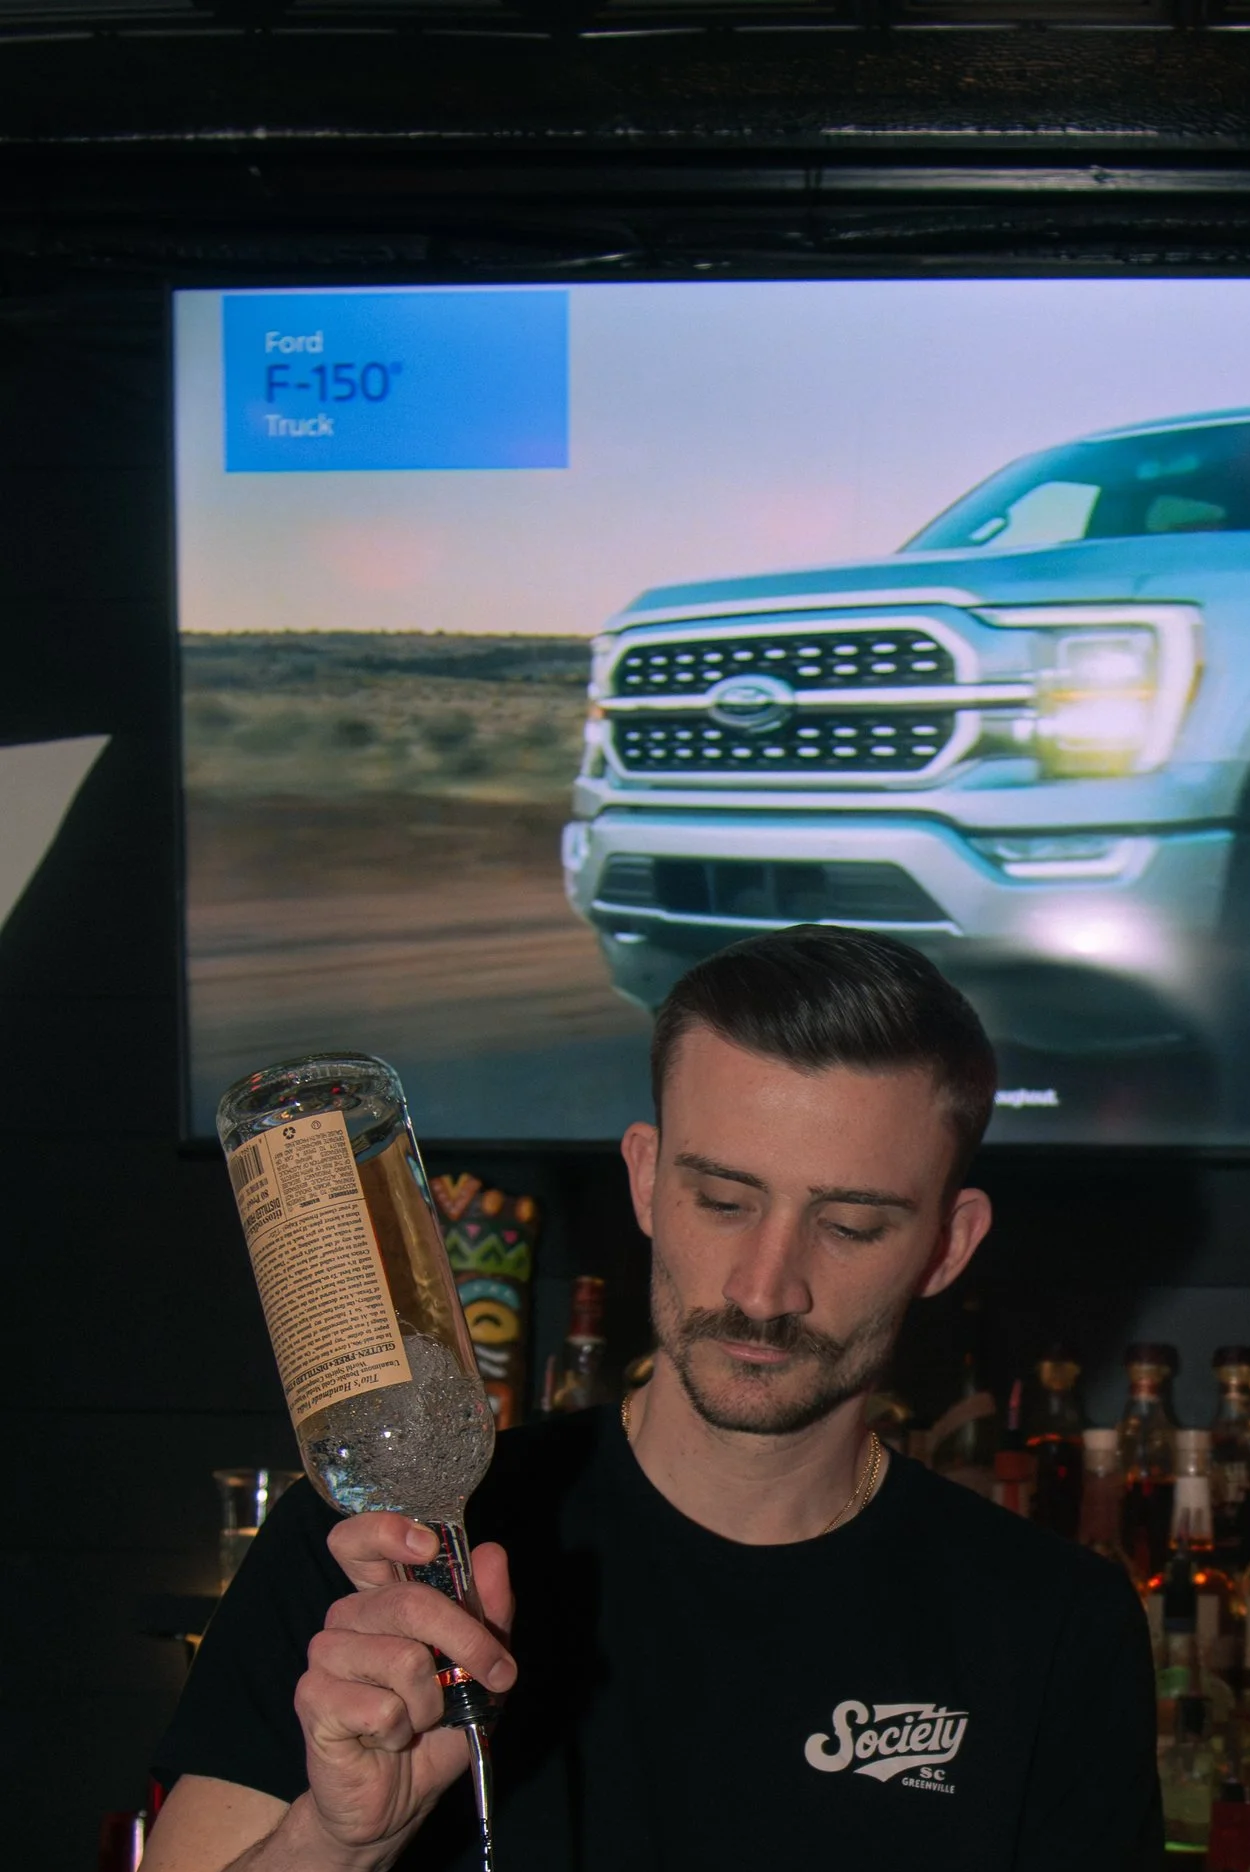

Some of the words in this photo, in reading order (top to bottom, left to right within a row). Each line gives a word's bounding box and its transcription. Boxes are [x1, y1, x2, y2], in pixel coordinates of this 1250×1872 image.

[265, 330, 324, 355] Ford
[265, 413, 334, 439] Truck
[345, 1359, 366, 1372] World
[360, 1359, 399, 1374] Unanimous
[335, 1369, 359, 1383] Double
[353, 1373, 379, 1388] Tito's
[311, 1381, 352, 1406] Handmade
[804, 1699, 970, 1783] Society
[919, 1766, 946, 1781] SC
[901, 1777, 956, 1795] GREENVILLE
